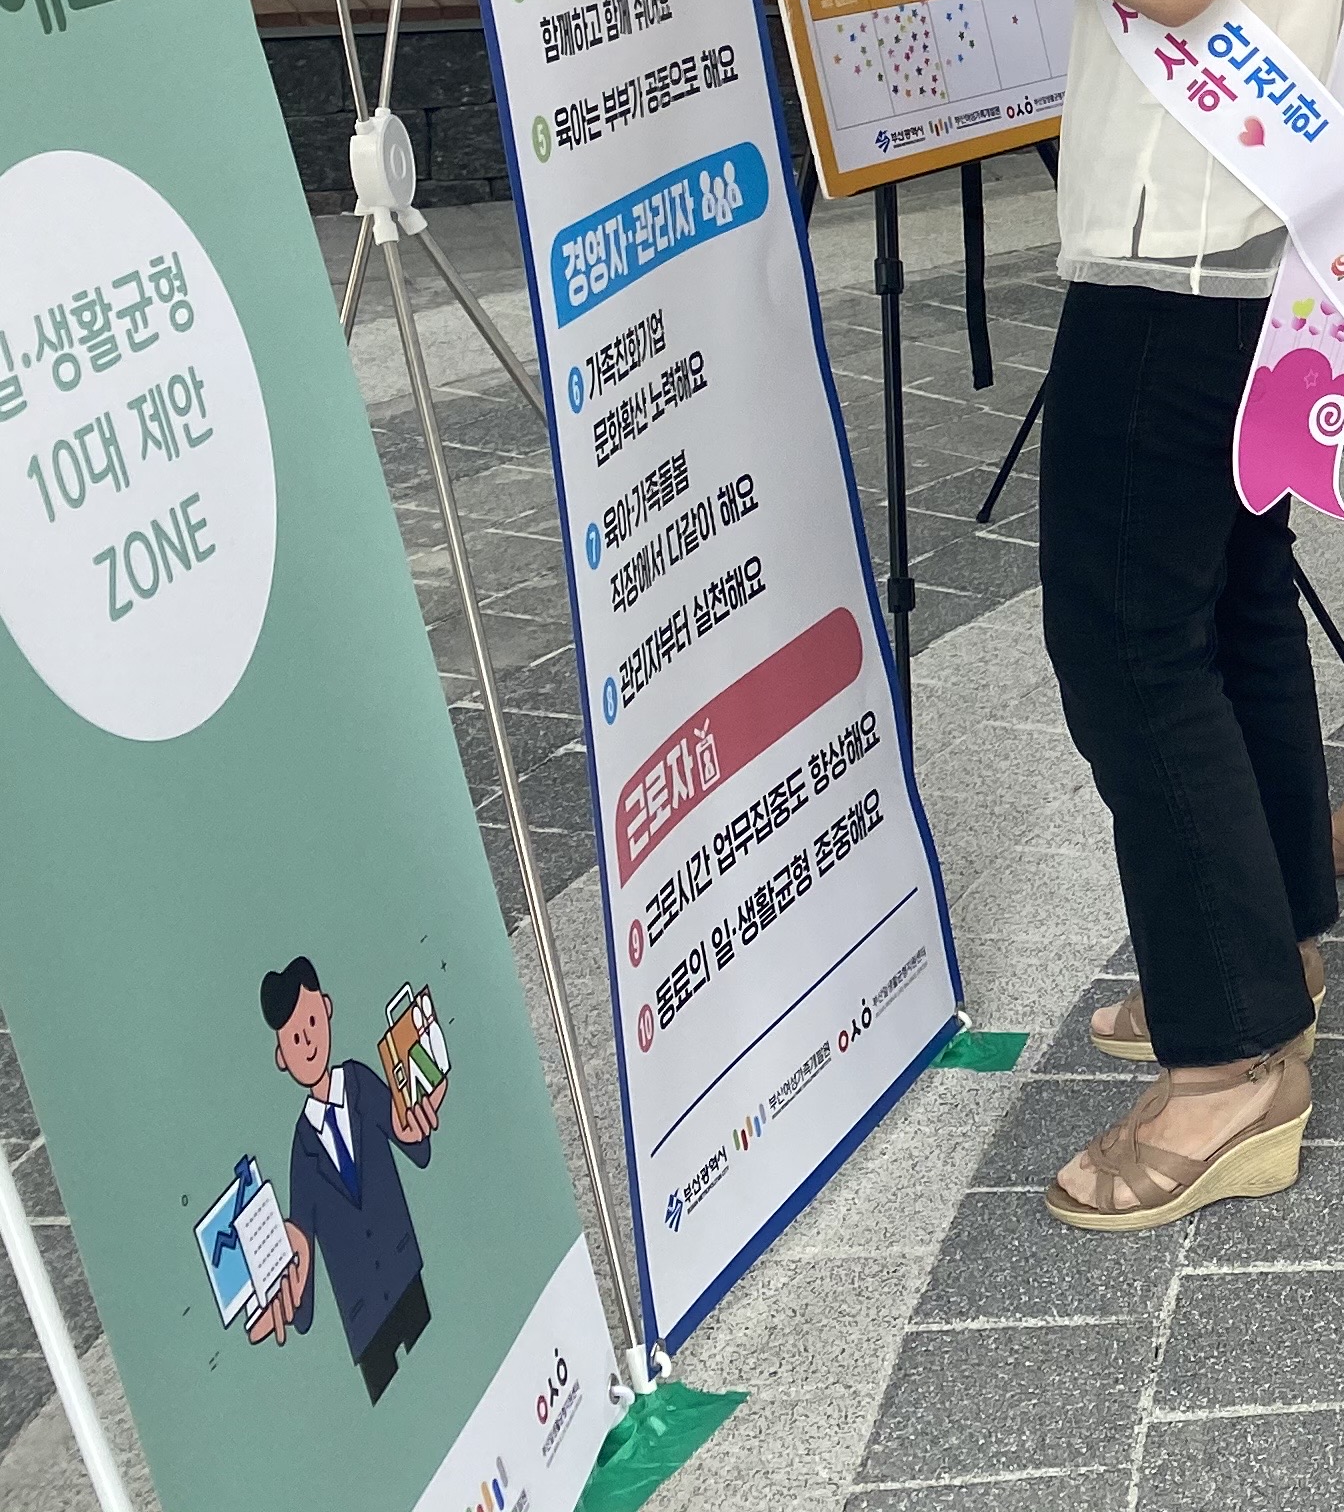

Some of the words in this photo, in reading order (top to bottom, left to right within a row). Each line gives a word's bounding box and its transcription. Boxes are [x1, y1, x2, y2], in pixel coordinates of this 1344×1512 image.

[540, 8, 602, 63] 함께하고
[1207, 21, 1330, 143] 안전한
[554, 99, 602, 152] 육아는
[602, 77, 644, 132] 부부가
[645, 56, 701, 116] 공동으로
[701, 44, 738, 92] 해요
[562, 179, 696, 307] 경영자·관리자
[585, 309, 668, 401] 가족친화기업
[593, 397, 648, 468] 문화확산
[649, 350, 708, 420] 노력해요
[27, 411, 130, 522] 10대
[127, 366, 213, 462] 제안
[603, 449, 690, 550] 육아·가족돌봄
[94, 493, 216, 622] ZONE
[610, 542, 665, 614] 직장에서
[667, 496, 717, 567] 다같이
[717, 473, 759, 528] 해요
[619, 604, 692, 709] 관리자부터
[693, 556, 767, 637] 실천해요
[625, 738, 694, 862] 근로자
[646, 846, 713, 948] 근로시간
[713, 767, 810, 876] 업무집중도
[808, 711, 881, 796] 향상해요
[656, 940, 711, 1030] 동료의
[710, 849, 813, 971] 일·생활균형
[813, 789, 885, 879] 존중해요
[683, 1145, 727, 1203] 부산광역시
